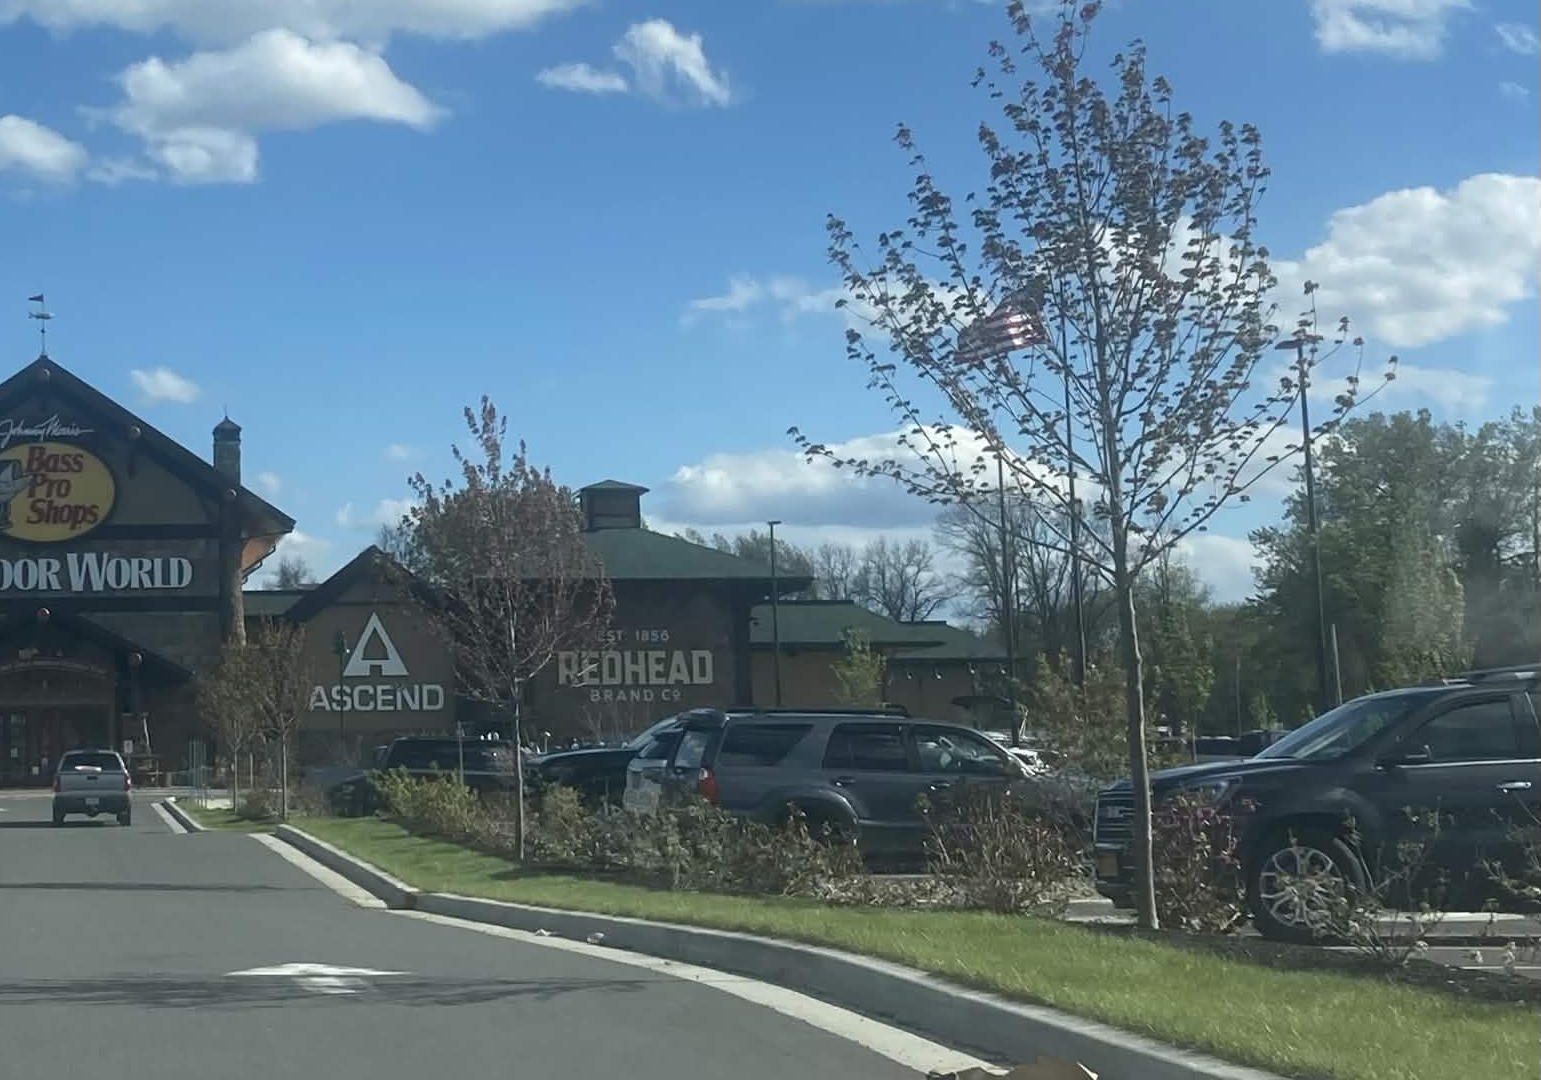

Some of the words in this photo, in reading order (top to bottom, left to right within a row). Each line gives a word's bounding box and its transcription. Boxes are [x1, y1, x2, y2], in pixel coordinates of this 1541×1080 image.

[26, 445, 84, 473] Bass
[27, 473, 72, 499] Pro
[26, 498, 100, 530] Shops
[634, 628, 671, 643] 1856
[558, 648, 714, 686] REDHEAD
[308, 683, 445, 712] ASCEND
[589, 688, 655, 703] BRAND
